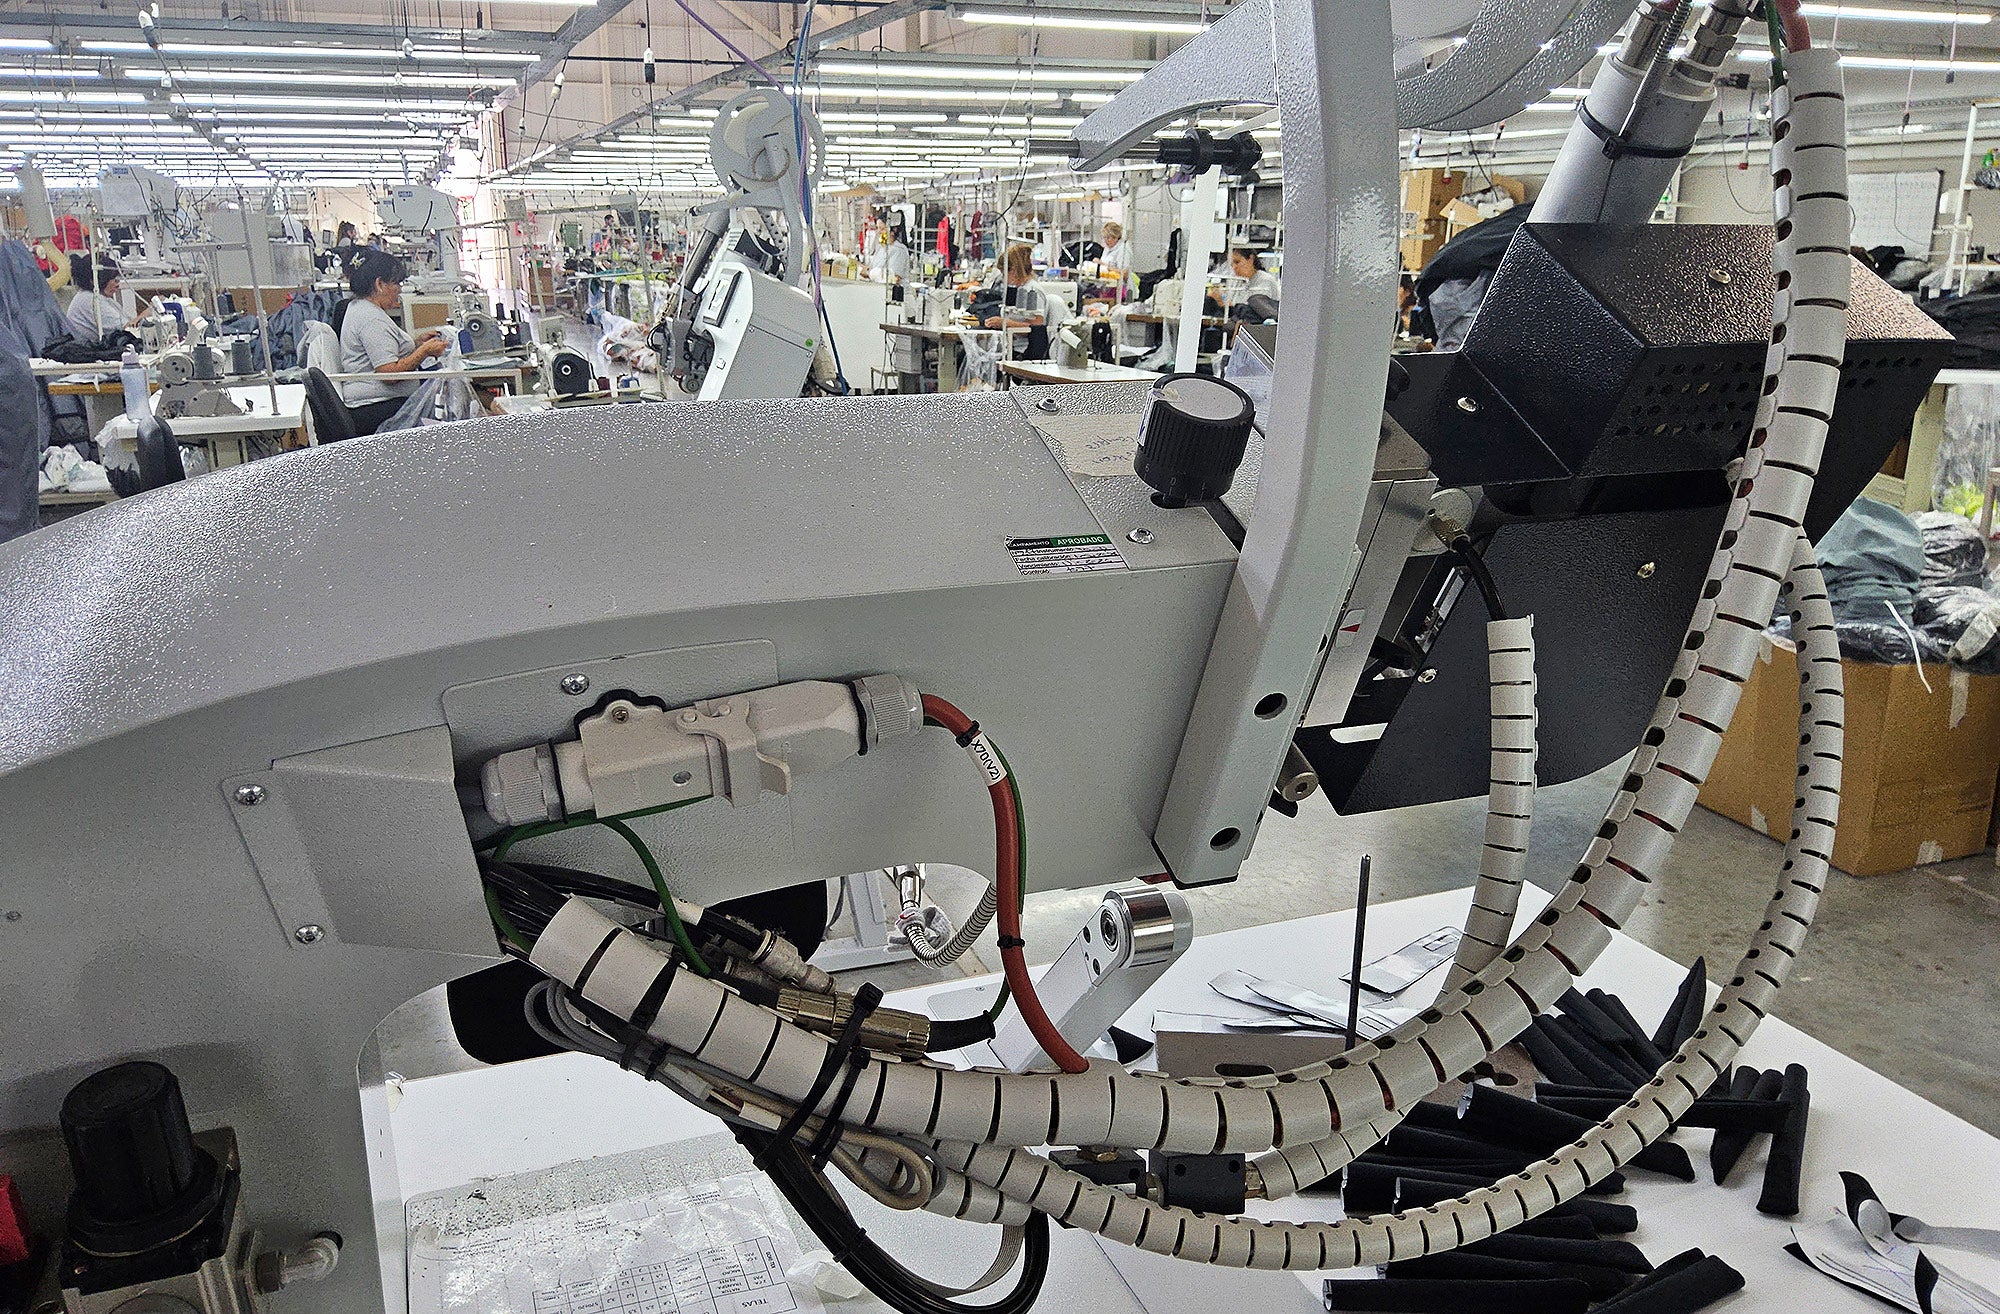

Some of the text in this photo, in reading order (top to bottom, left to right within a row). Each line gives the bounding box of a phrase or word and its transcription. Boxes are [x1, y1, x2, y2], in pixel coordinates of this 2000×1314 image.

[1057, 536, 1104, 546] APROBADO
[971, 739, 1001, 780] X70(V2)
[742, 1298, 768, 1308] TELAS
